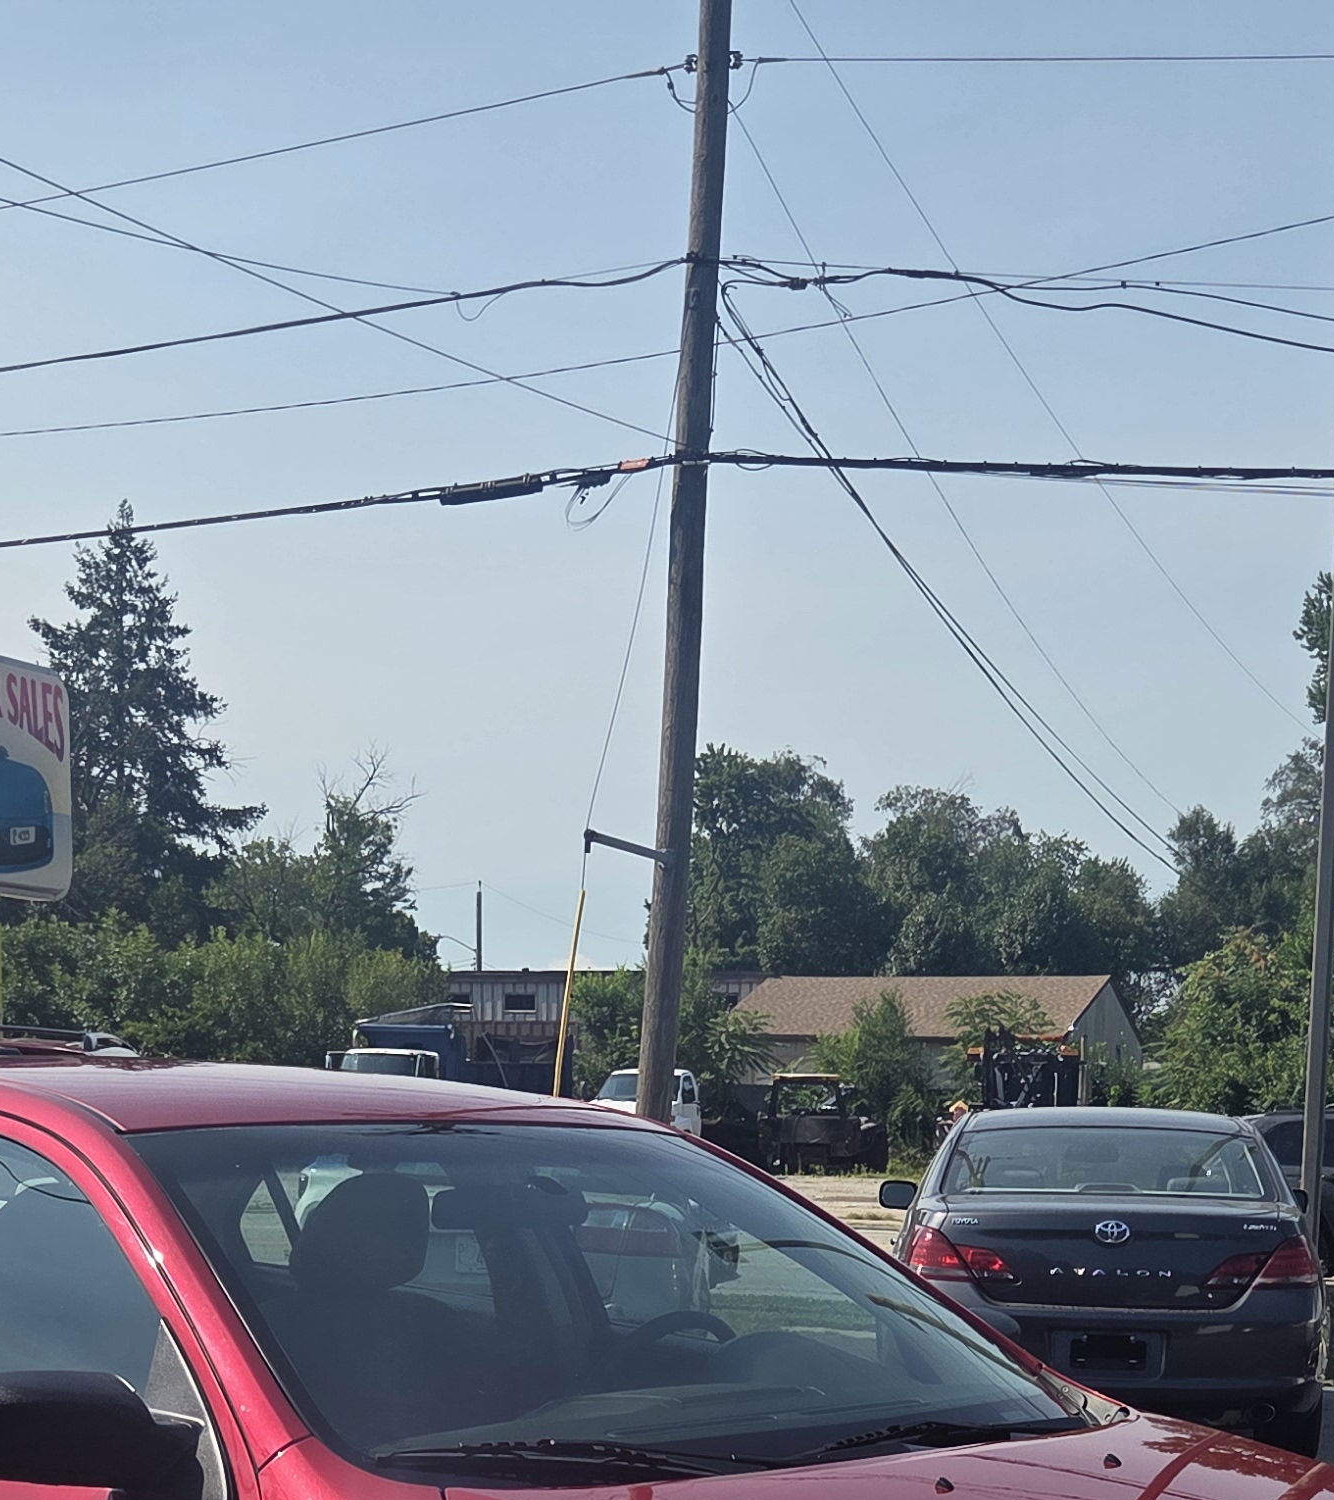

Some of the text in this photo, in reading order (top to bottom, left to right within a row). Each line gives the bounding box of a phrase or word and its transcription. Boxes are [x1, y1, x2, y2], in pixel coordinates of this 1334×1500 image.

[5, 672, 65, 763] SALES
[951, 1217, 979, 1225] TOYOTA
[1049, 1267, 1172, 1278] AVALON
